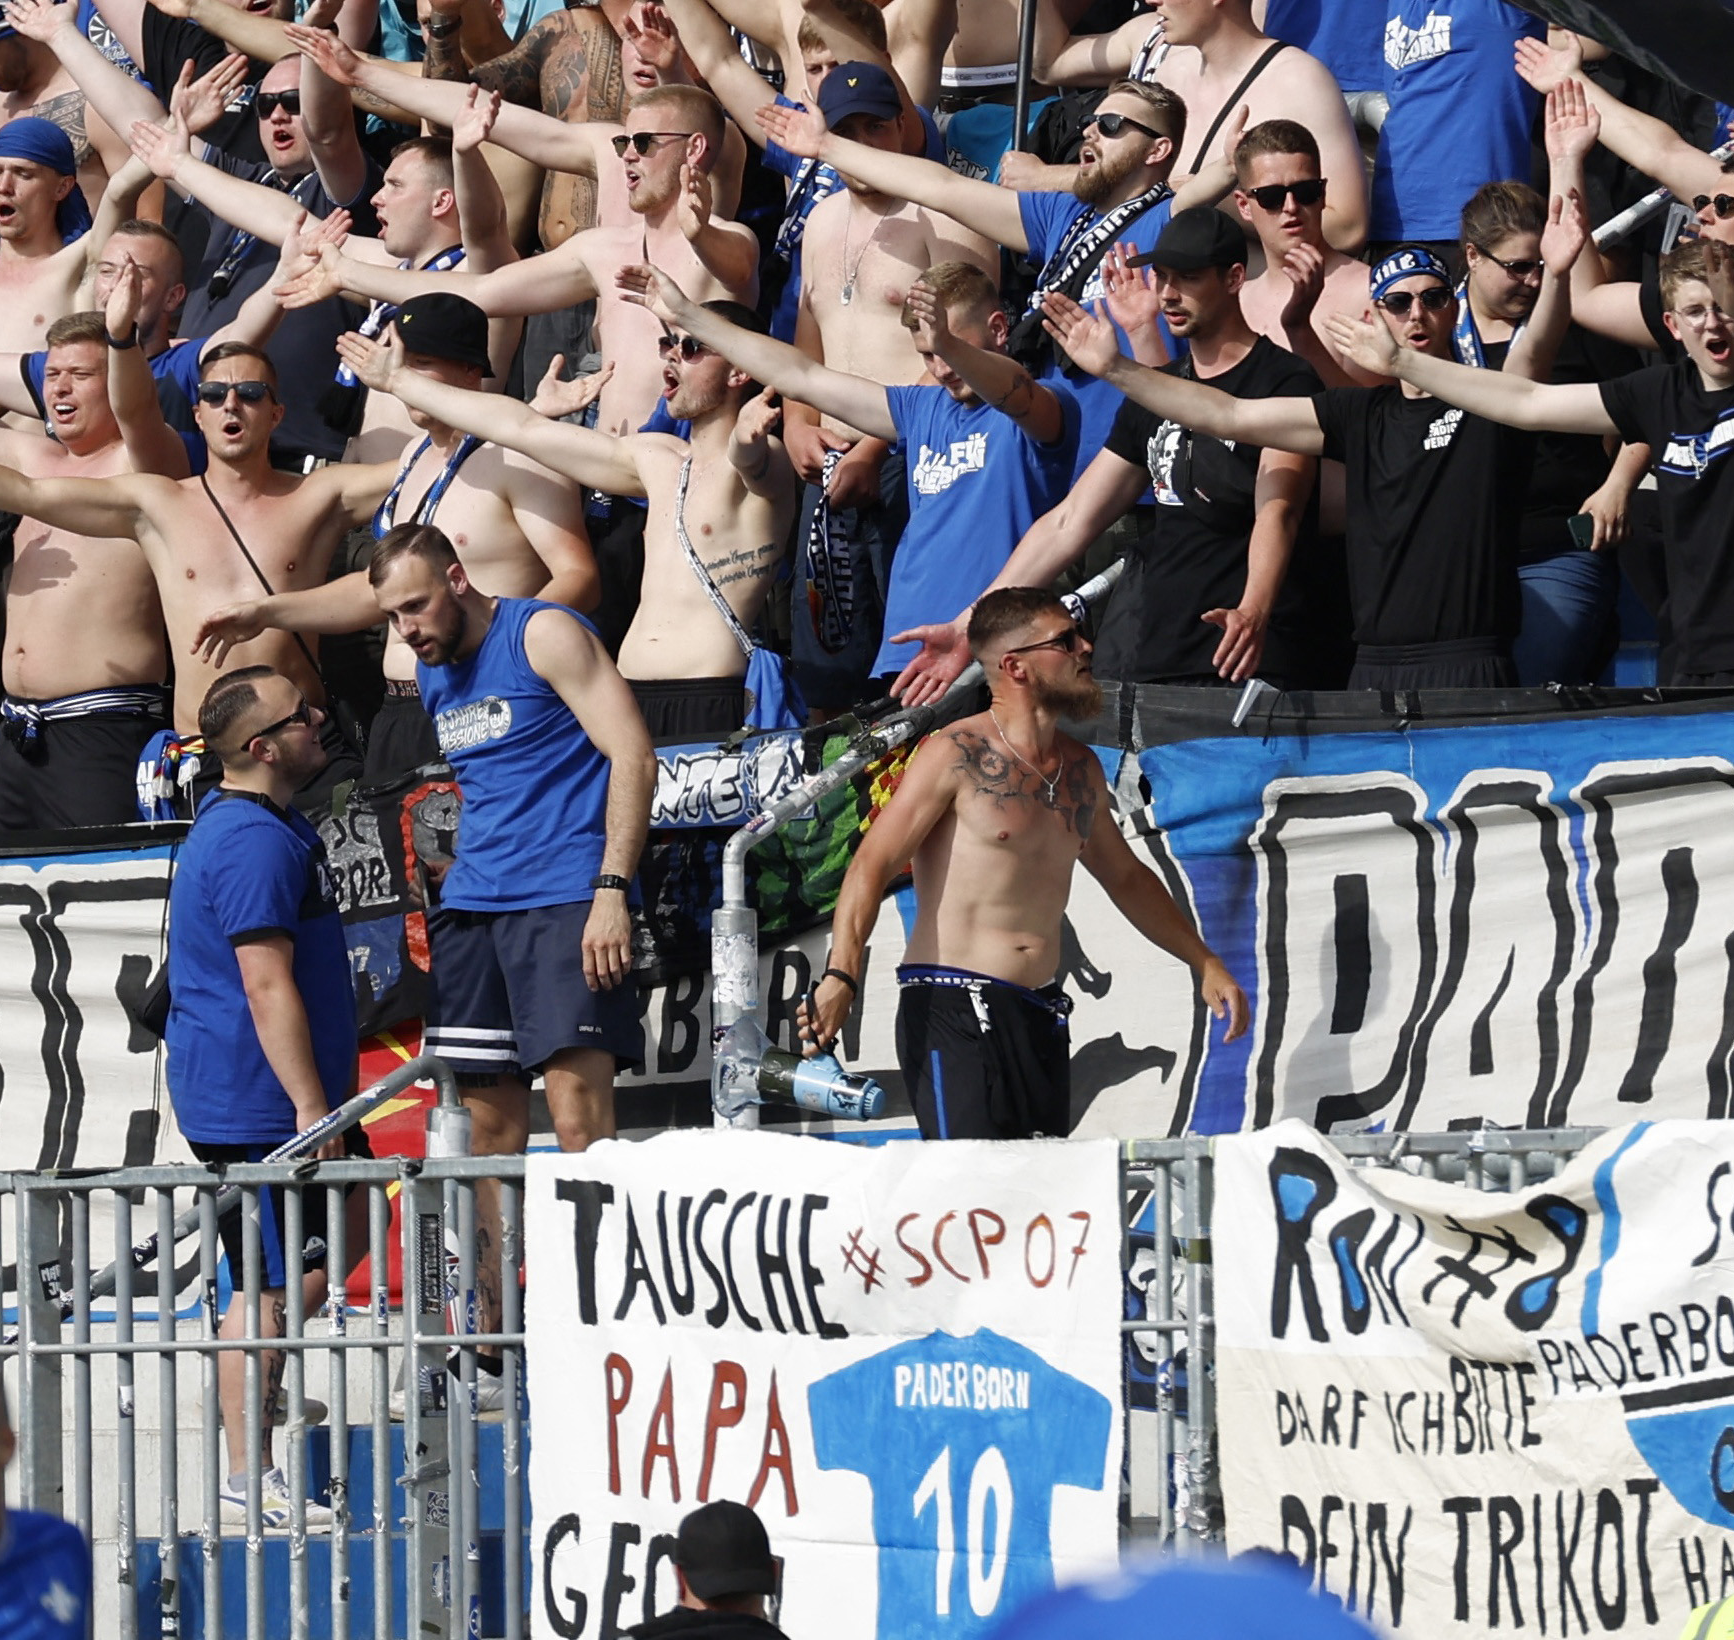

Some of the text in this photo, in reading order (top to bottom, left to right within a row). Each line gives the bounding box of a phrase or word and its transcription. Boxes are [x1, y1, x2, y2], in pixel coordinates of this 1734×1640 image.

[554, 1177, 849, 1340] TAUSCHE
[840, 1208, 1007, 1296] #SCP
[1022, 1210, 1092, 1291] 07
[604, 1350, 800, 1518] PAPA
[894, 1361, 1031, 1412] PADERBORN
[1275, 1358, 1543, 1456] DARF ICH BITTE
[911, 1443, 1015, 1618] 10
[1279, 1491, 1415, 1630] DEIN
[1441, 1476, 1662, 1639] TRIKOT
